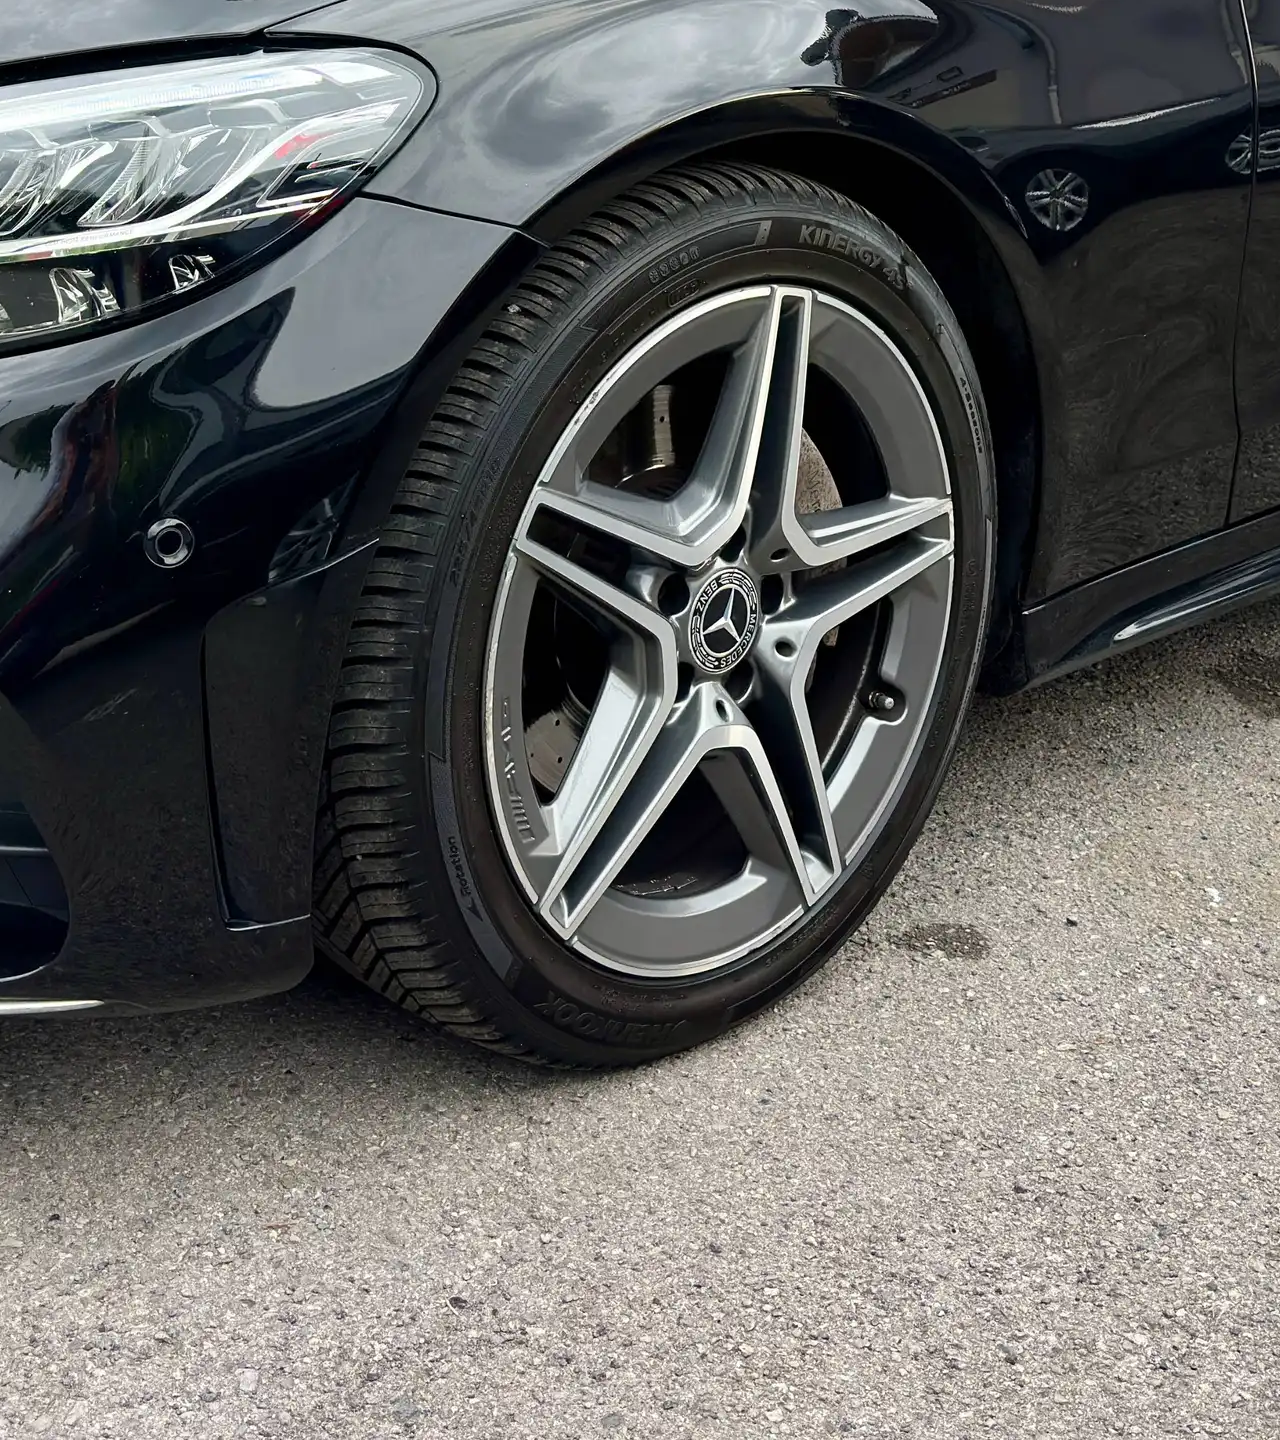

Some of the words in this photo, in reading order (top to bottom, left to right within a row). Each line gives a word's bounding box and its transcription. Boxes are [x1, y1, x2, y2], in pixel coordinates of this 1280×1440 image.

[798, 223, 883, 269] KINERGY
[695, 579, 718, 612] BENZ
[720, 613, 757, 668] MERCEDES
[447, 835, 472, 897] Rotation
